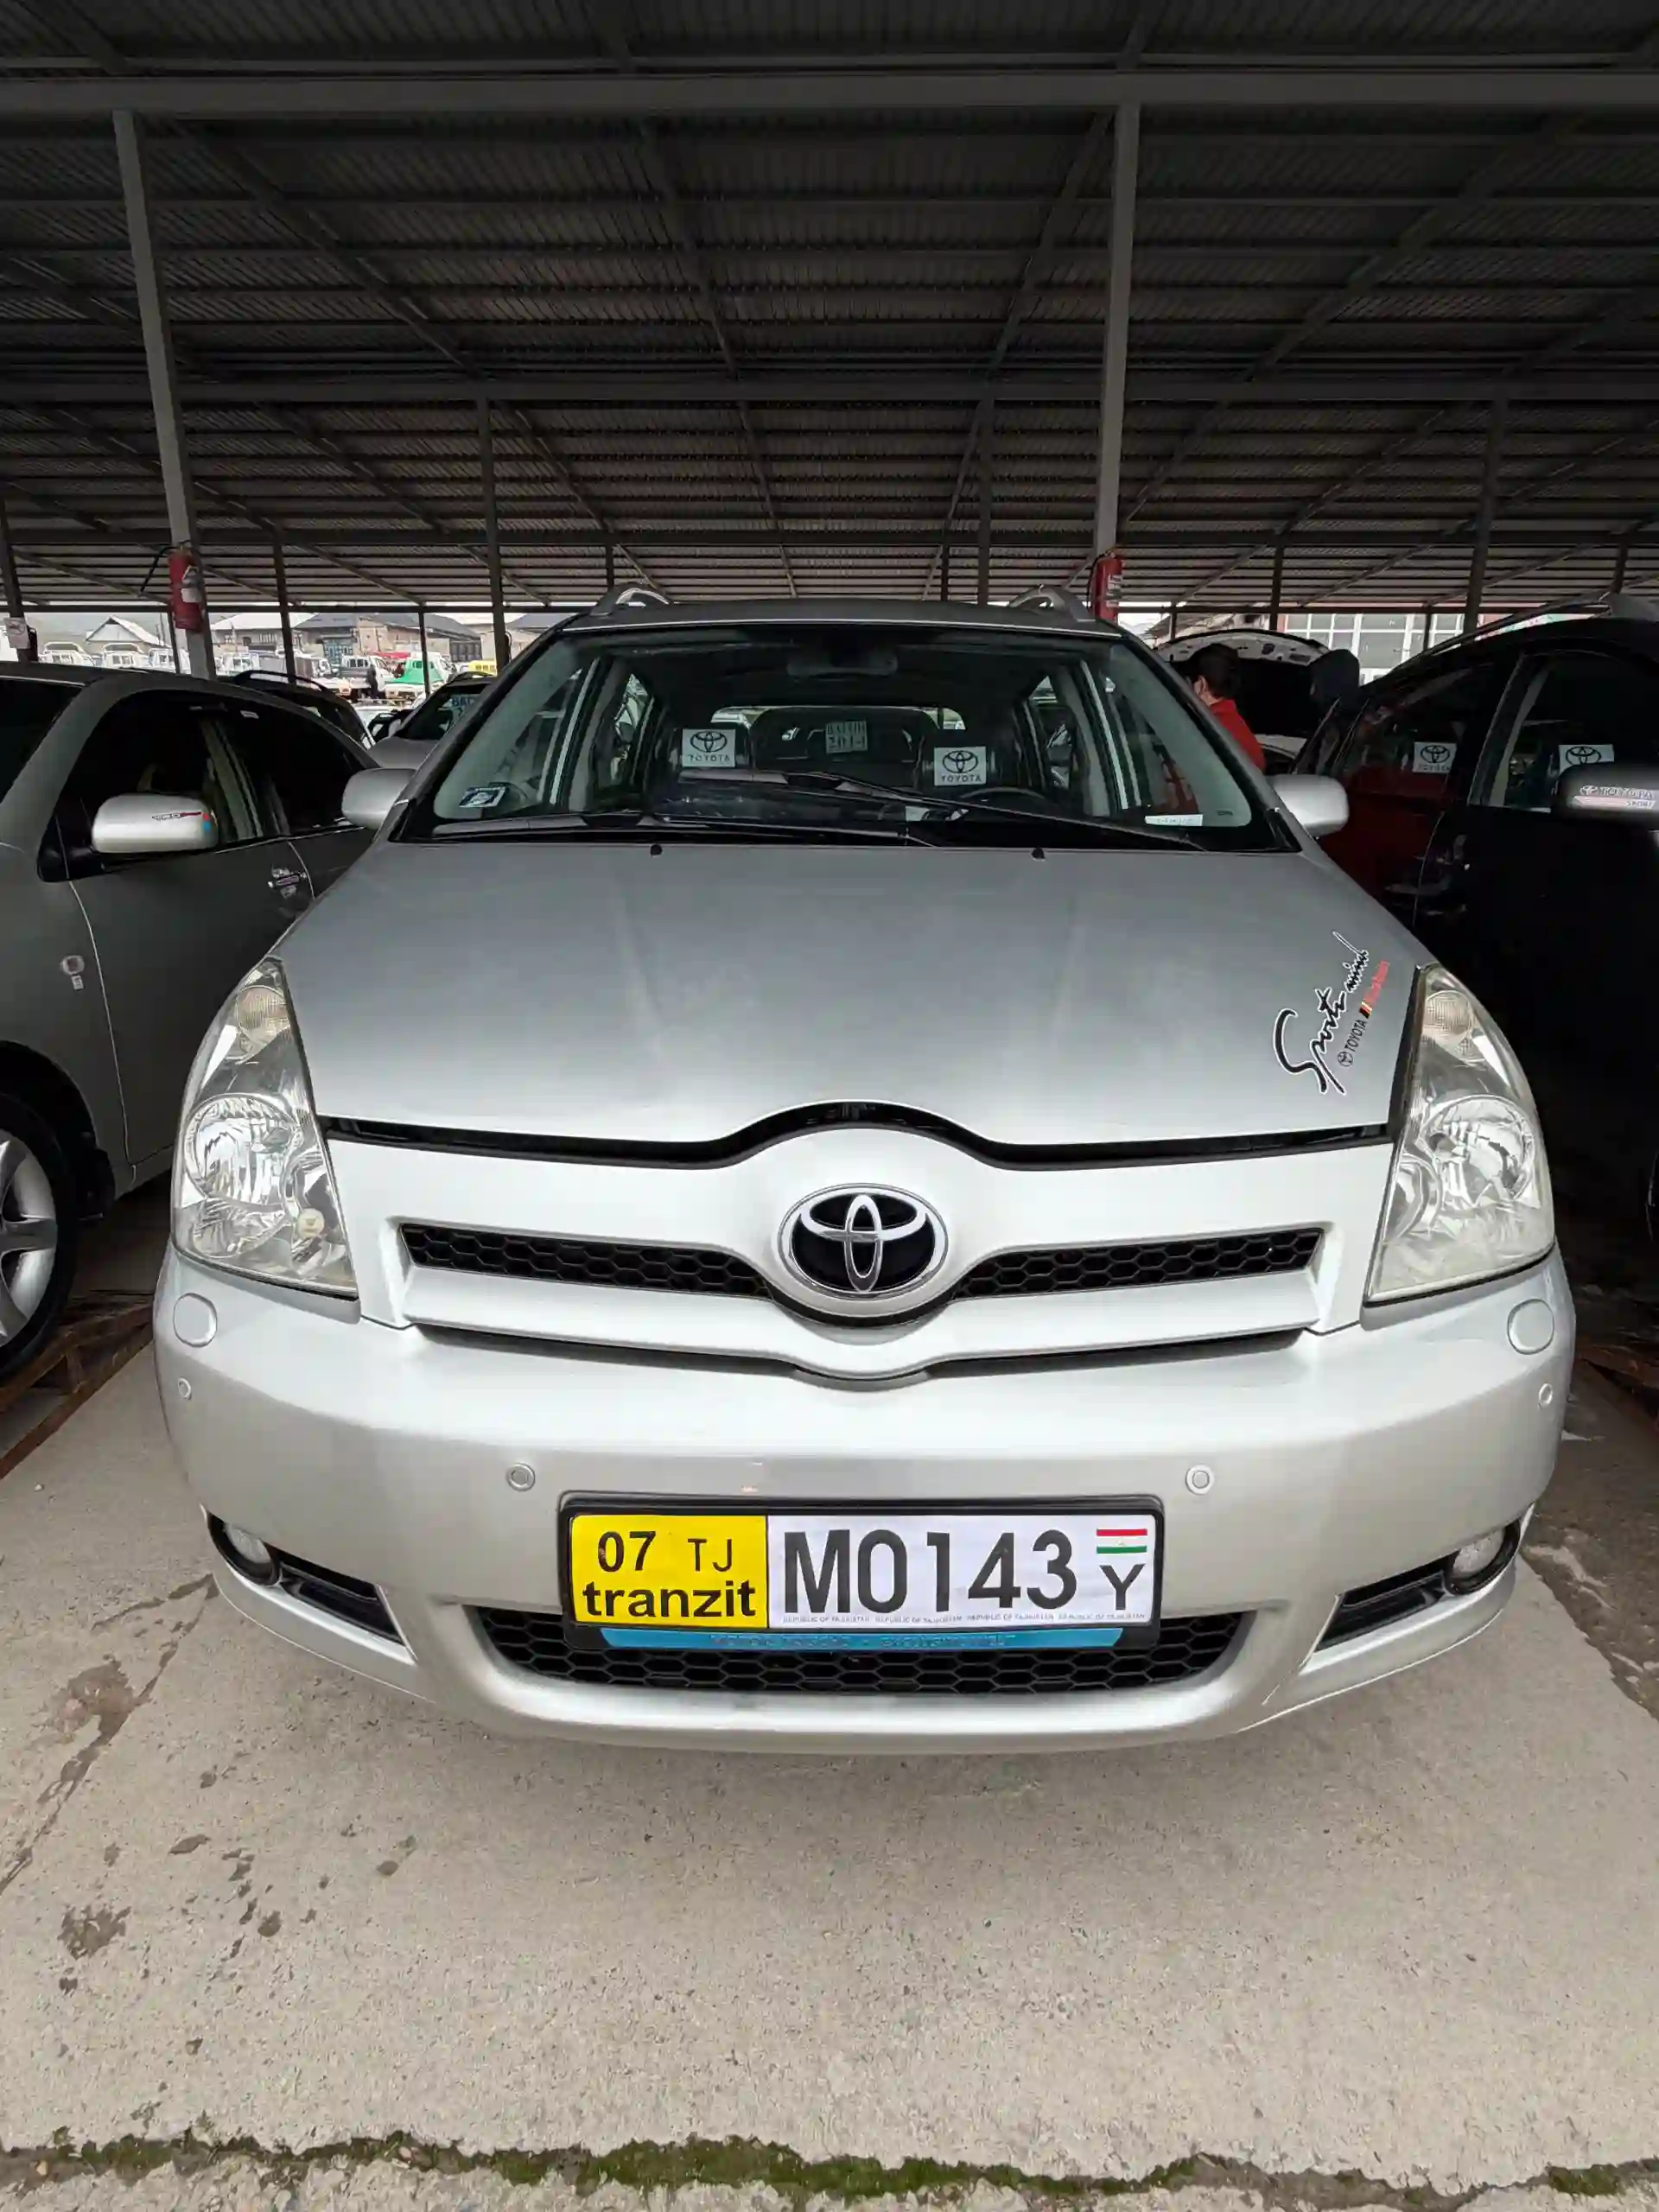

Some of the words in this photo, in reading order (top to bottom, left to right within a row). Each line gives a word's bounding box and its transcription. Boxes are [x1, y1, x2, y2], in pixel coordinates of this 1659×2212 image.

[942, 774, 982, 783] TOYOTA
[1600, 786, 1654, 799] TOYOTA
[1343, 1019, 1369, 1052] TOYOTA
[598, 1530, 657, 1573] 07
[687, 1538, 733, 1573] TJ
[582, 1579, 757, 1618] tranzit
[1098, 1563, 1147, 1611] Y
